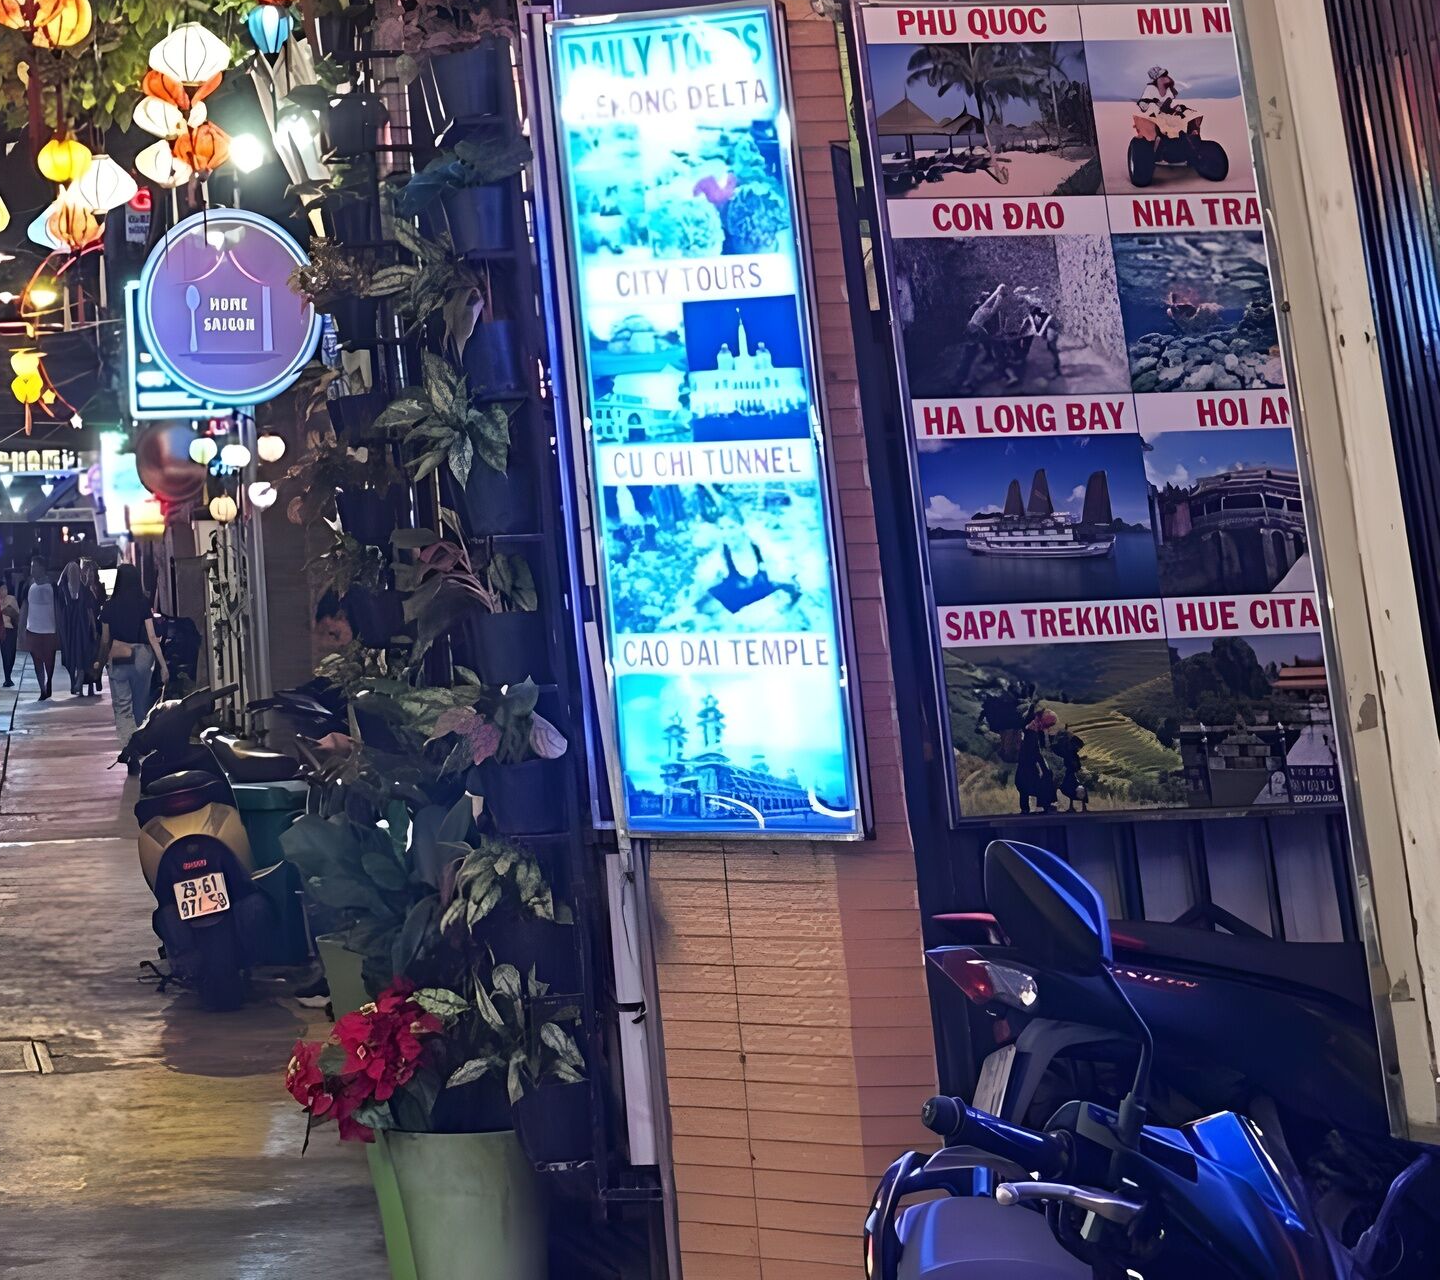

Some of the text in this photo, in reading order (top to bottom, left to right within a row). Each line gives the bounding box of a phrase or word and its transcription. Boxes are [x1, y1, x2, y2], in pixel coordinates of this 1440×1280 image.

[896, 7, 1048, 39] PHU QUOC
[1136, 6, 1192, 35] MUI
[567, 21, 763, 78] DAILY TOS
[687, 78, 769, 111] DELTA
[931, 201, 1066, 232] CON ĐAO
[1132, 199, 1193, 228] NHA
[615, 262, 764, 297] CITY TOURS
[209, 297, 248, 311] HOME
[203, 317, 256, 332] SAIGON
[923, 401, 1127, 436] HA LONG BAY
[1196, 398, 1249, 428] HOI
[613, 446, 803, 478] CU CHI TUNNEL
[944, 604, 1160, 641] SAPA TREKKING
[1175, 602, 1239, 632] HUE
[623, 638, 830, 668] CAO DAI TEMPLE
